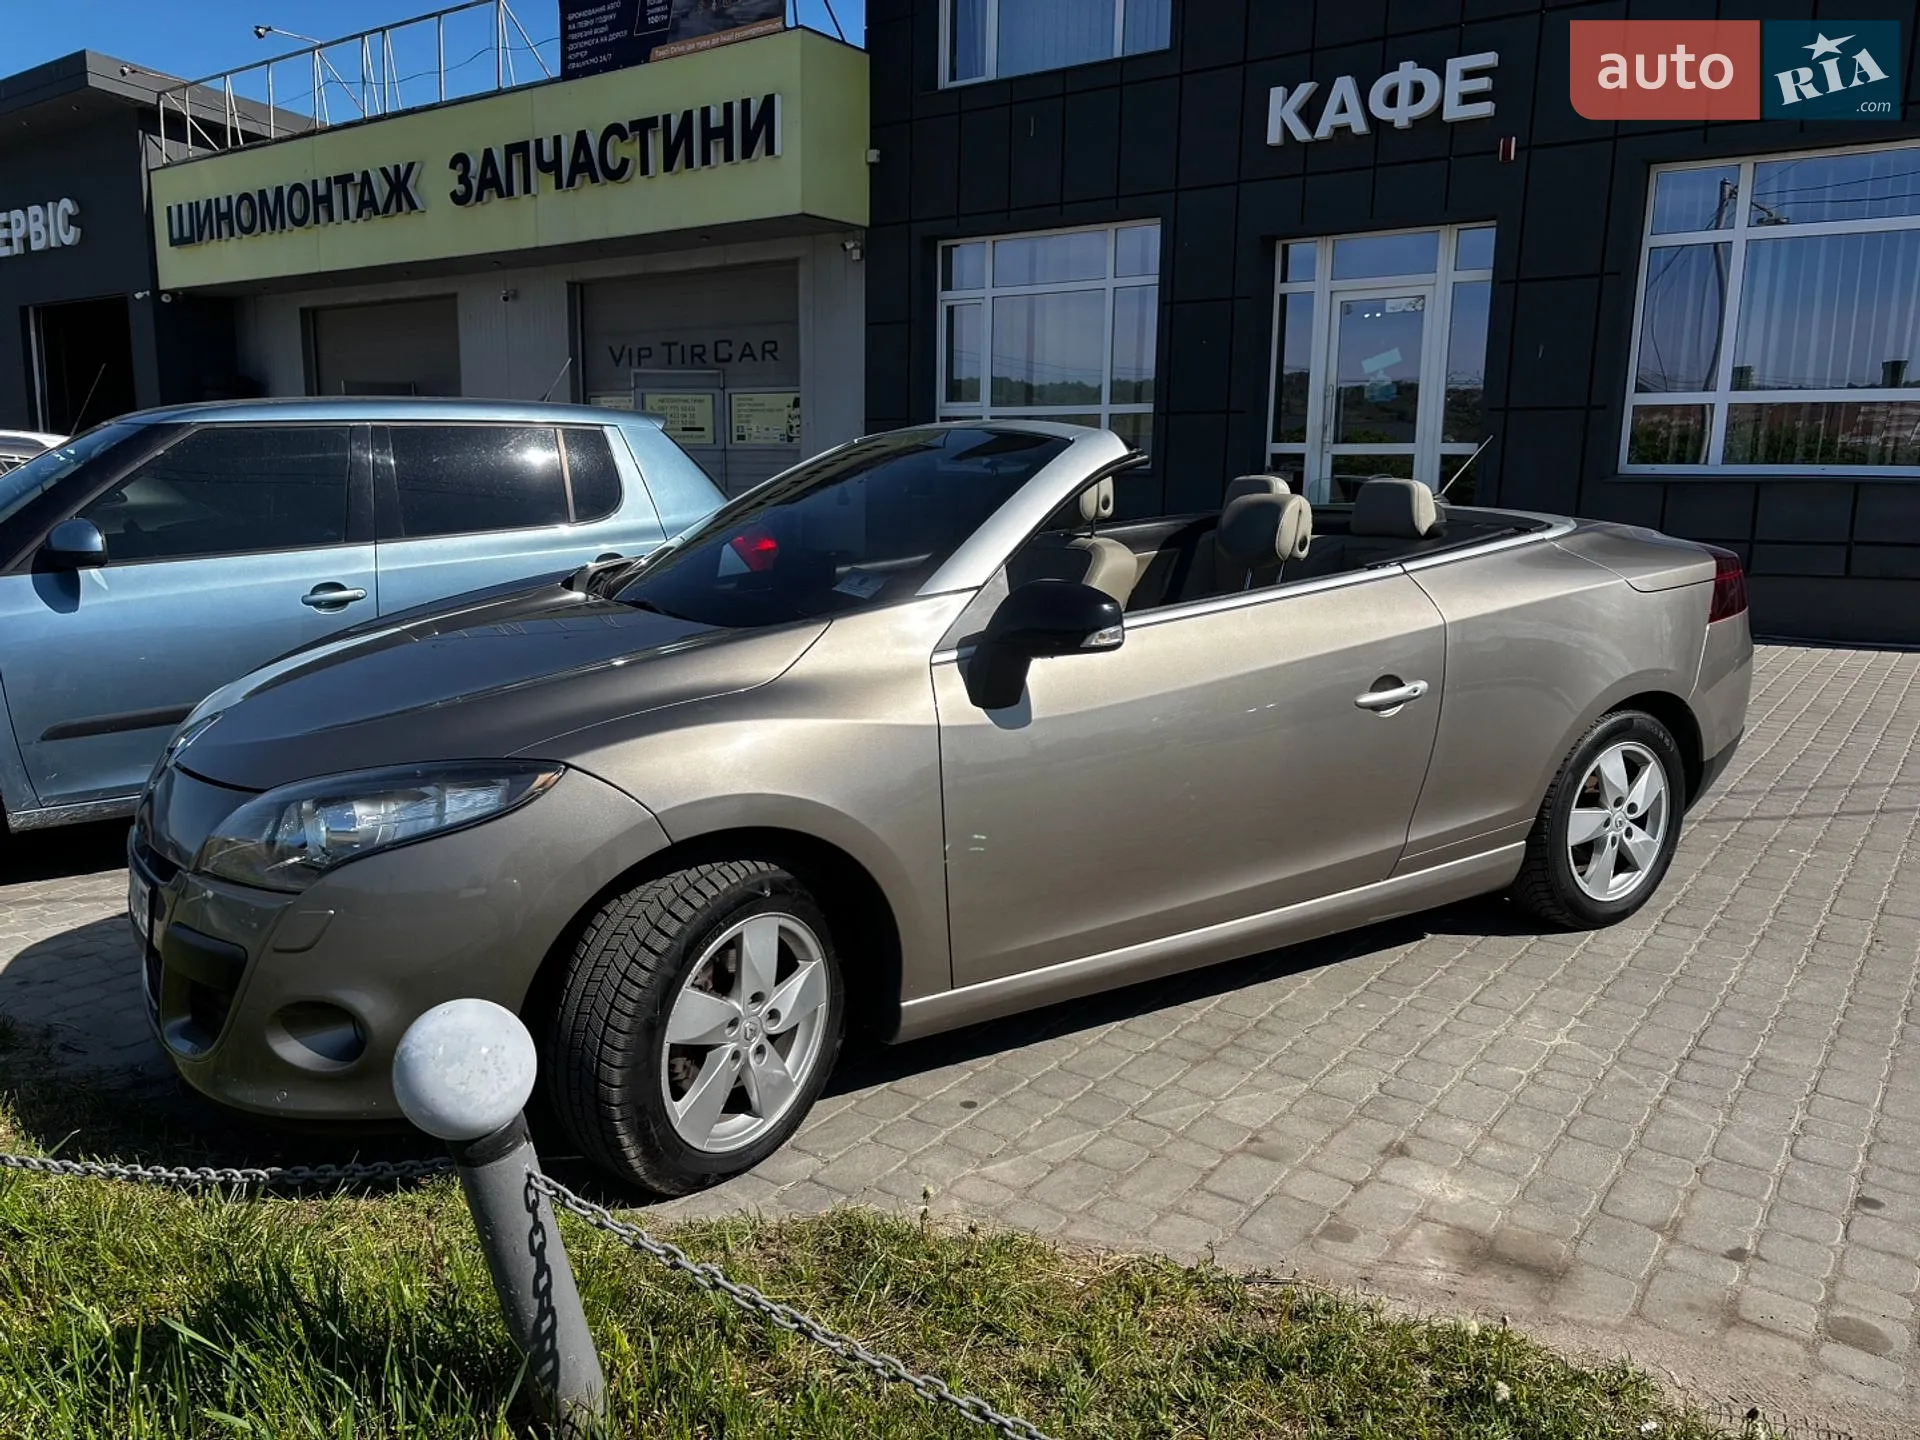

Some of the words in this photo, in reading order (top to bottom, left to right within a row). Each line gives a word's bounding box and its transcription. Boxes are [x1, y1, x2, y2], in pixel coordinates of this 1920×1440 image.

[1266, 50, 1500, 146] КАФЕ
[166, 160, 425, 248] ШИНОМОНТАЖ
[449, 93, 783, 208] ЗАПЧАСТИНИ
